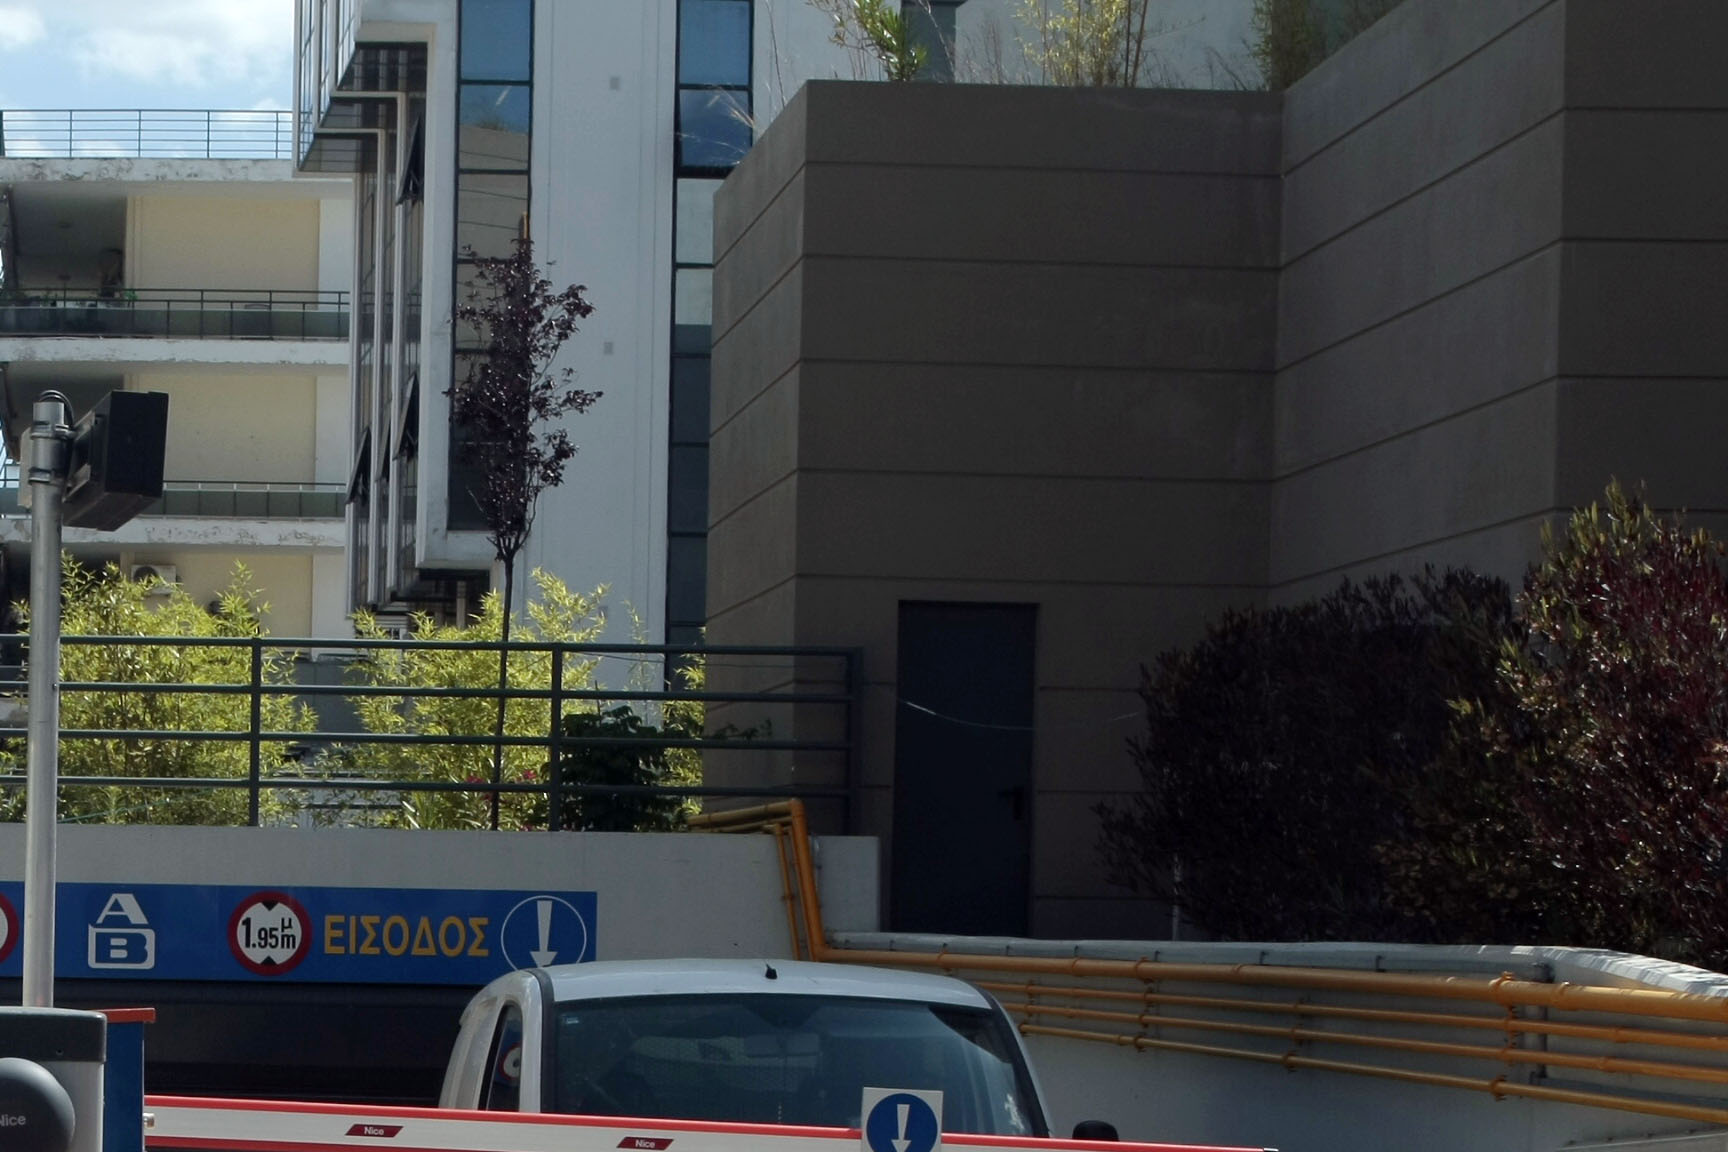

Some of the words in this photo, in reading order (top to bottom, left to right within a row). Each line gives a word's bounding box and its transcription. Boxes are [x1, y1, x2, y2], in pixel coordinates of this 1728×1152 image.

[324, 915, 489, 957] ΕΙΣΟΔΟΣ
[364, 1126, 384, 1136] Nice
[635, 1139, 656, 1149] Nice
